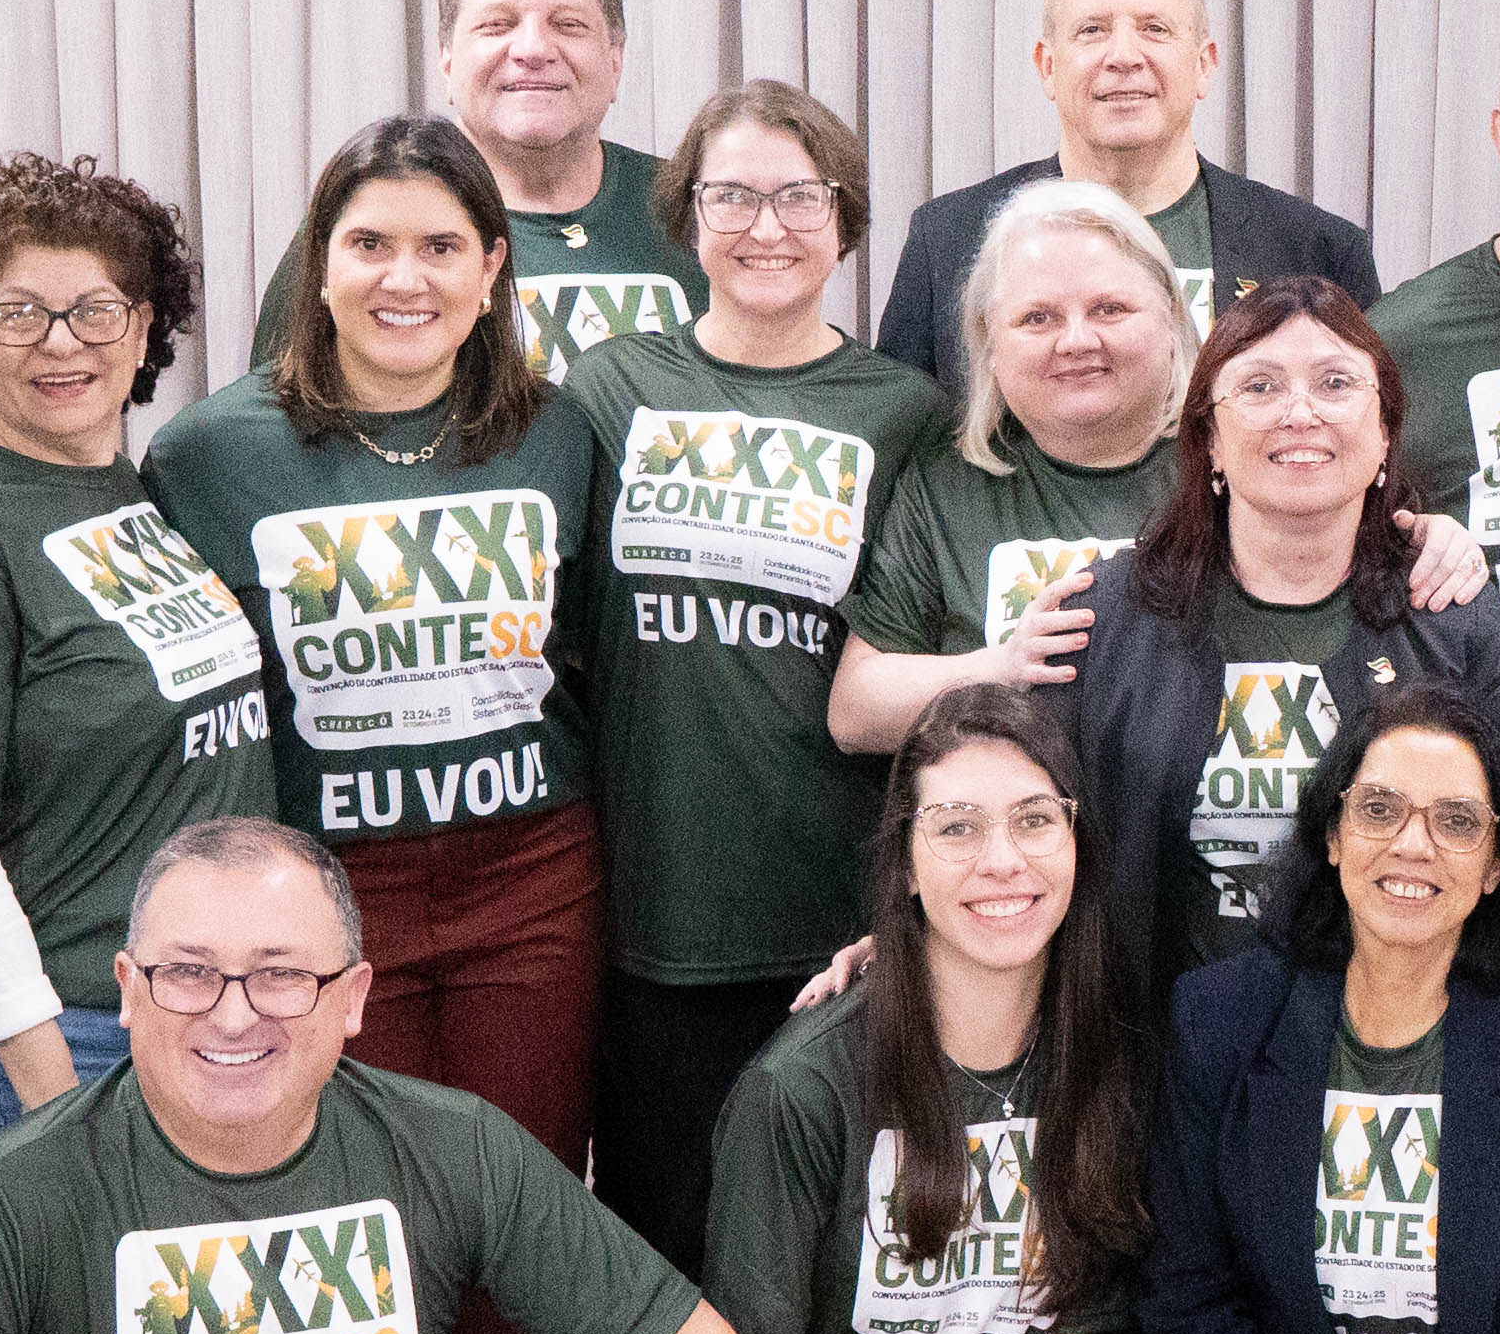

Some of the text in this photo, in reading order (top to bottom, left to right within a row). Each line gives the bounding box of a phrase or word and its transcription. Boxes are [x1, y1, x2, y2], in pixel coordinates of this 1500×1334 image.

[638, 421, 858, 507] XXXI
[625, 480, 852, 547] CONTESC
[292, 502, 546, 627] XXXI
[293, 611, 542, 682] CONTESC
[634, 593, 829, 655] EU VOU!
[438, 670, 449, 680] DO
[402, 709, 415, 720] 23
[418, 708, 431, 719] 24
[437, 706, 451, 717] 25
[320, 742, 548, 830] EU VOU!
[1315, 1256, 1373, 1268] CONTABILIDADE
[1385, 1262, 1415, 1272] ESTADO
[1416, 1264, 1426, 1272] DE
[1342, 1289, 1386, 1299] 23 24 25
